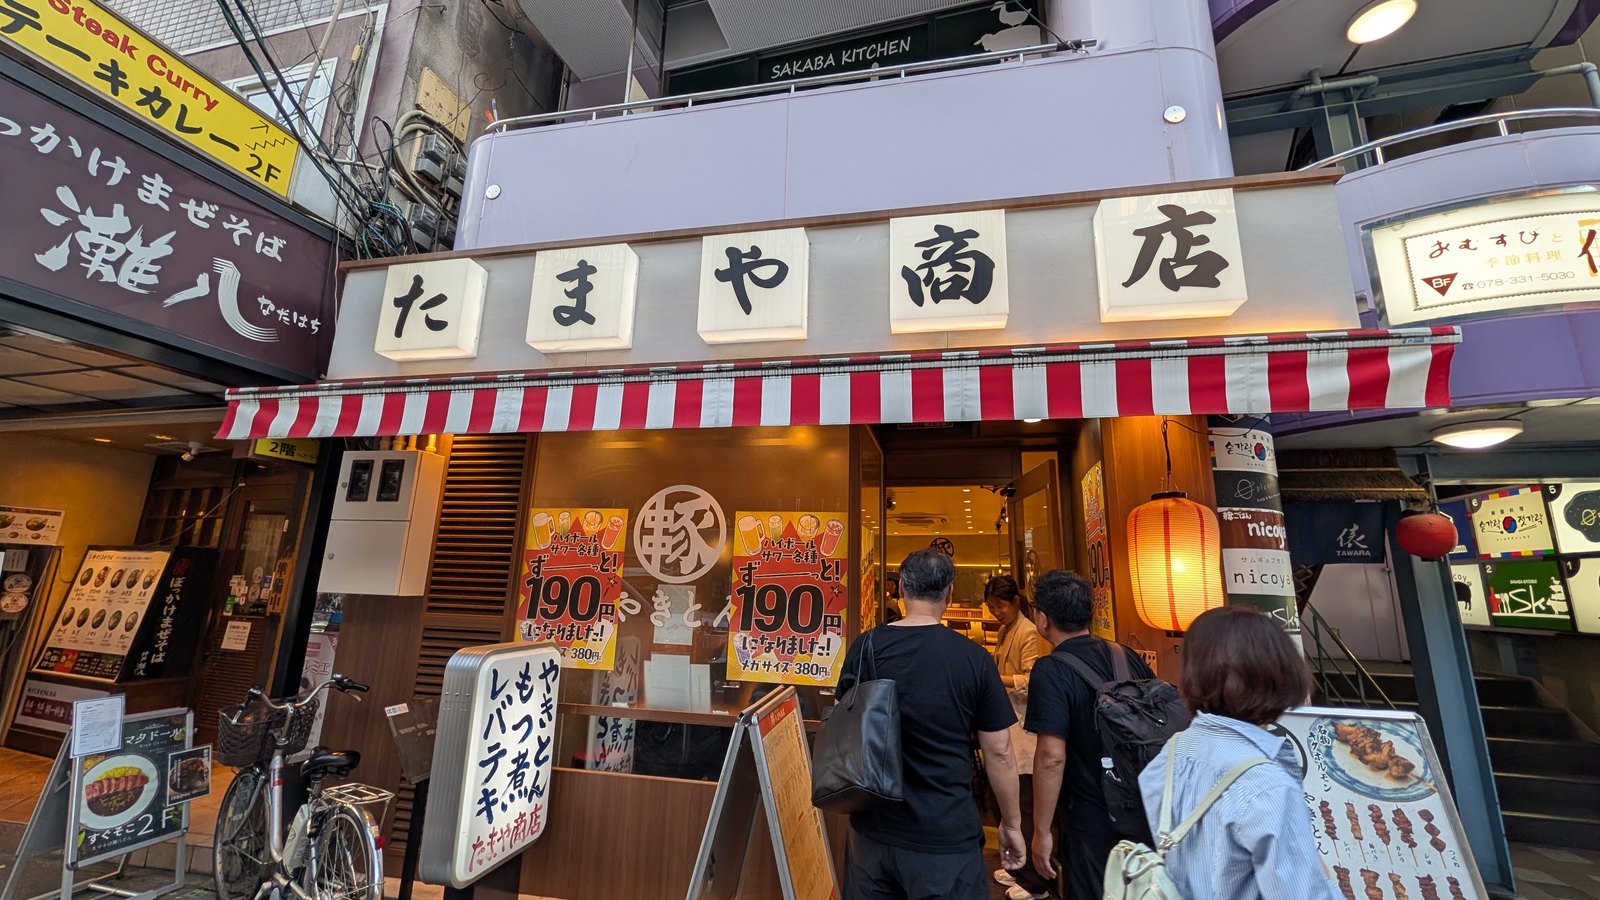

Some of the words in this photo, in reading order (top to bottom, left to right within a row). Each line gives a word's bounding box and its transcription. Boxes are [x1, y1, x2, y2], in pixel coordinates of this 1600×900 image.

[47, 0, 140, 61] Steak
[146, 53, 220, 113] Curry
[770, 55, 836, 80] SAKABA
[841, 36, 912, 67] KITCHEN
[245, 152, 282, 183] 2F
[1428, 227, 1541, 259] おむすび
[392, 203, 1231, 339] たまや商店
[1476, 270, 1576, 290] 078-331-5030
[257, 294, 323, 335] なだはち
[550, 544, 600, 556] サワー各種
[552, 532, 599, 544] ハイボール
[763, 538, 817, 550] ハイボール
[761, 550, 819, 564] サワー各種
[1485, 565, 1493, 574] 2
[1566, 561, 1573, 571] 1
[150, 576, 187, 664] ぼっかけまぜそば
[741, 660, 793, 674] メガサイズ
[124, 727, 182, 745] マタドール
[475, 668, 514, 825] レバテキ
[501, 661, 535, 813] もつ煮
[528, 658, 560, 804] やきとん
[1308, 731, 1332, 793] キクホルモン
[87, 822, 136, 845] すぐそこ
[468, 803, 543, 873] たまや商店
